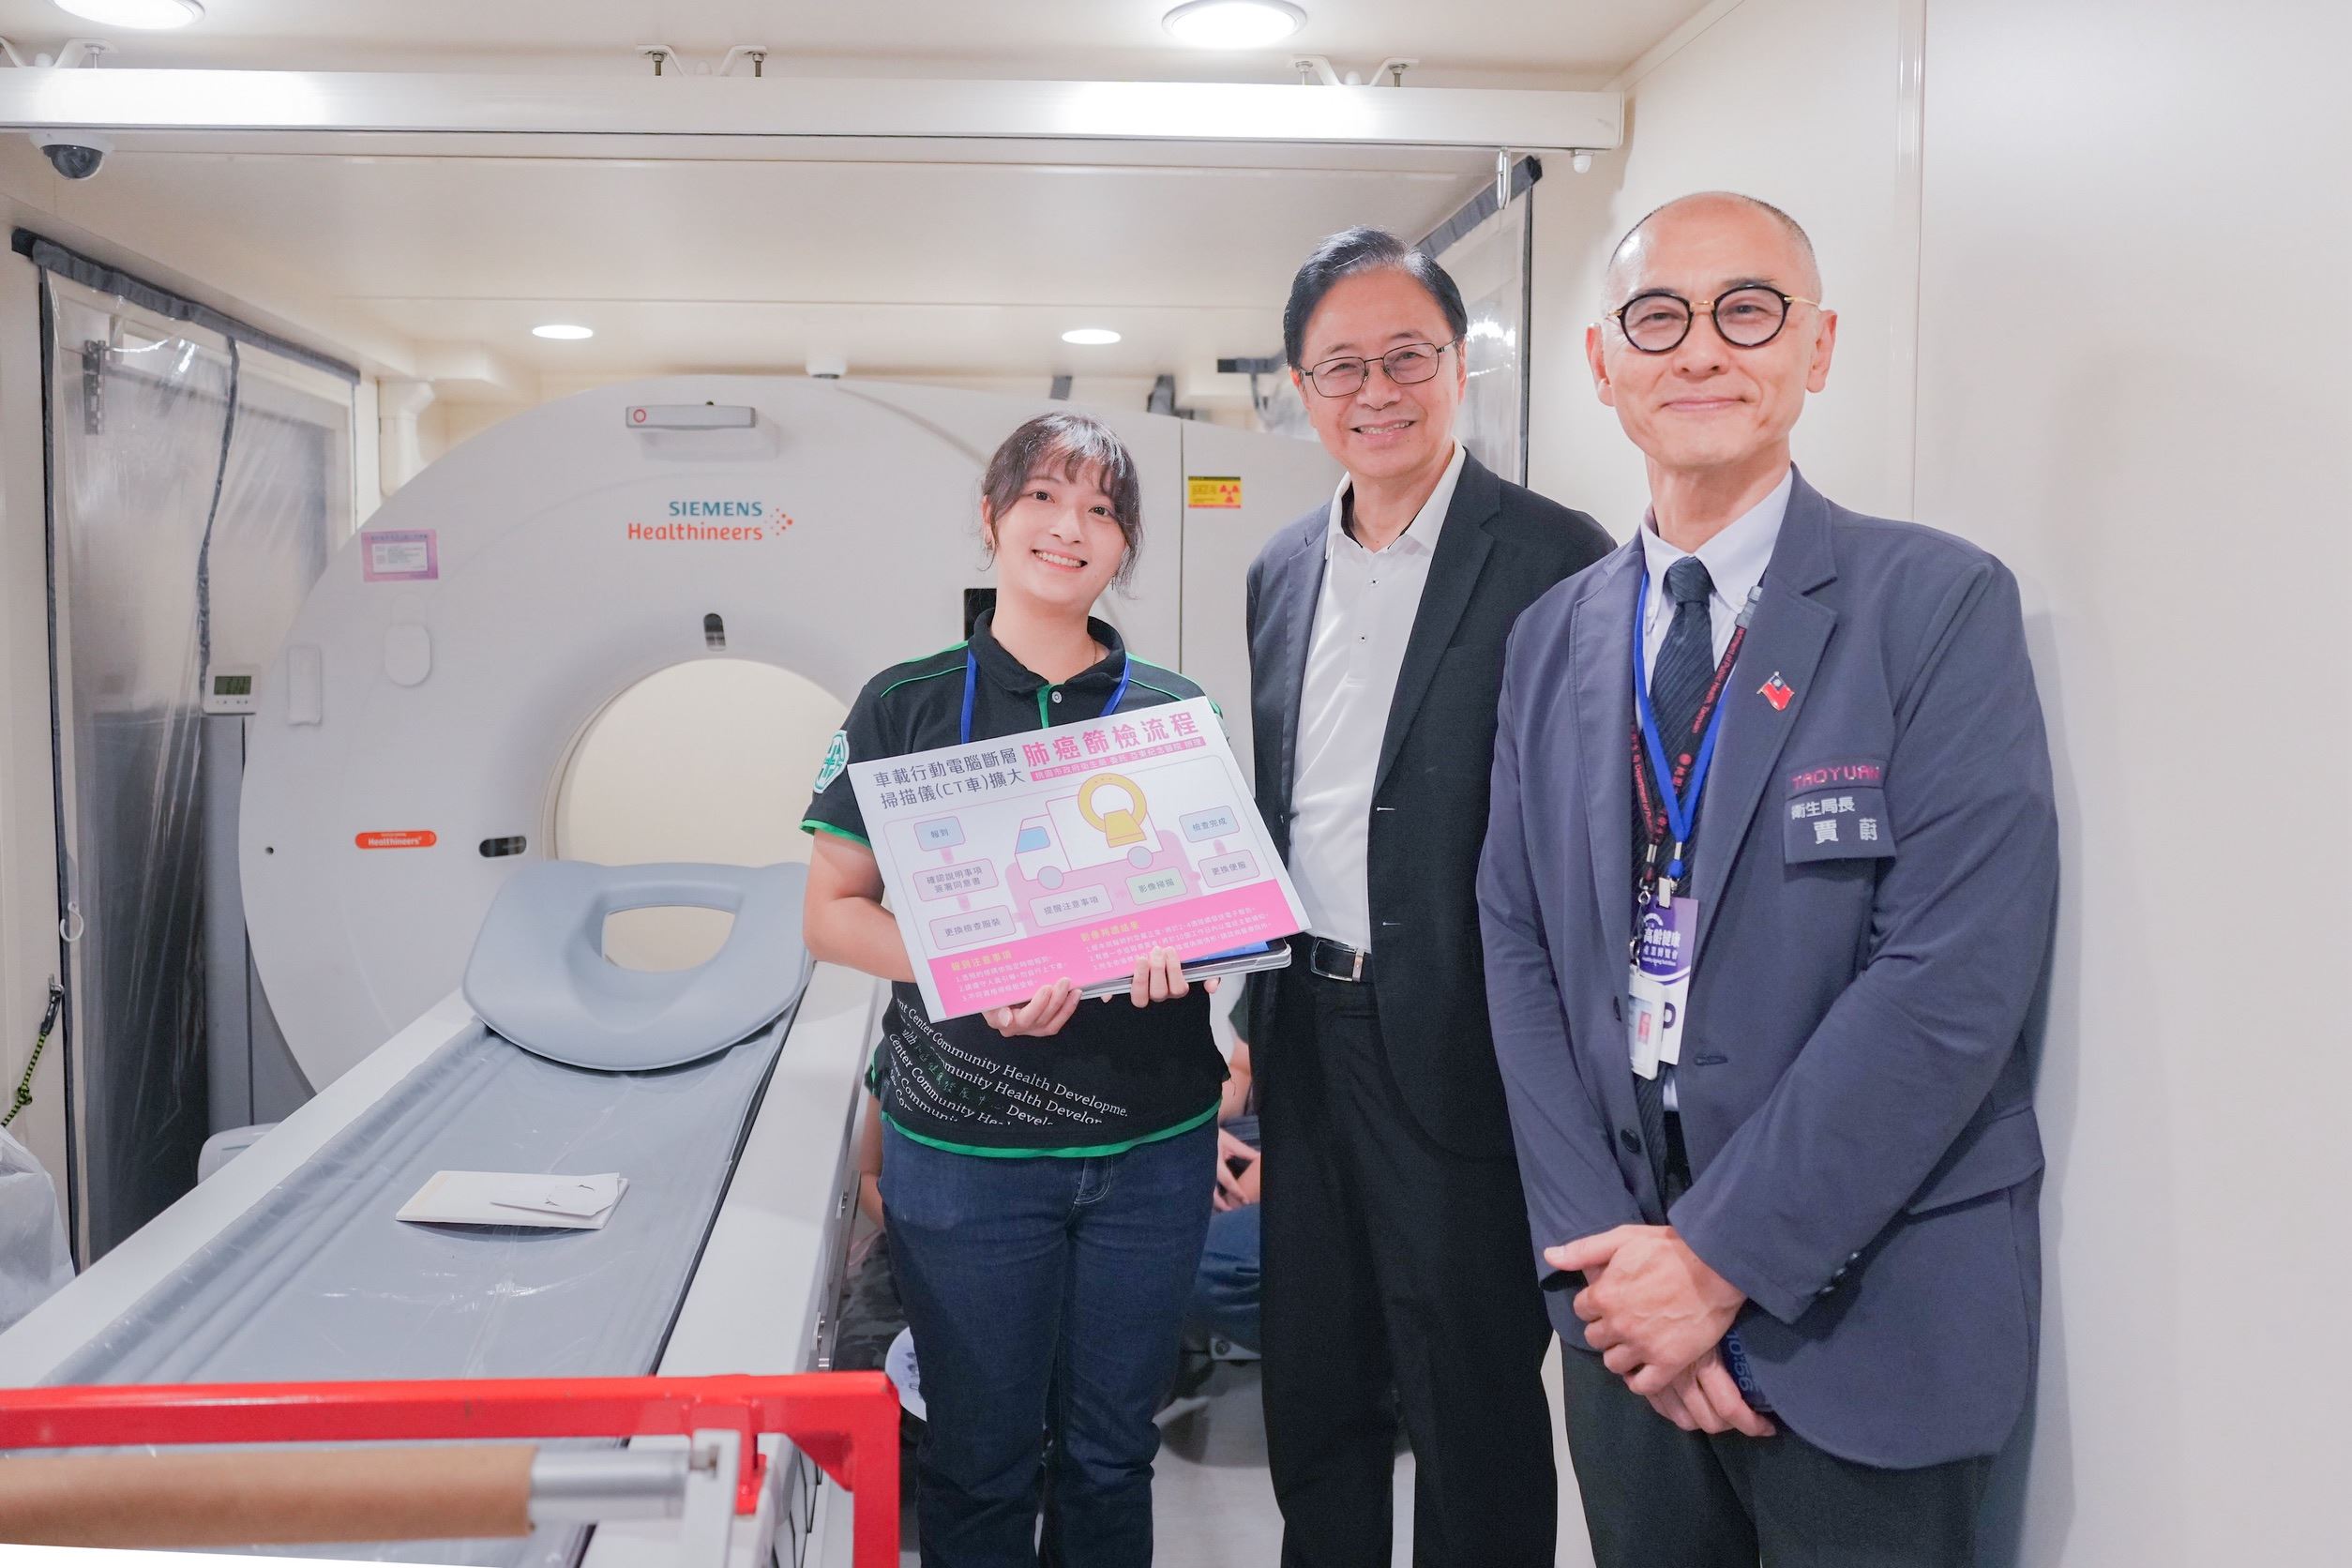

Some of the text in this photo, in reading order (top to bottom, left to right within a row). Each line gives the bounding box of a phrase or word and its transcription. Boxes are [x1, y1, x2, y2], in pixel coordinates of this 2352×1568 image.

[669, 501, 762, 517] SIEMENS
[627, 521, 763, 540] Healthineers
[1021, 711, 1199, 767] 肺癌篩檢流程
[873, 747, 1017, 788] 車載行動電腦斷層
[1791, 764, 1880, 790] TAOYUAN
[881, 768, 1026, 810] 掃描儀(CT車)擴大
[1791, 795, 1856, 820] 衛生局長
[930, 828, 949, 838] 報到
[1192, 817, 1228, 832] 檢查完成
[927, 866, 983, 884] 確認說明事項
[1211, 861, 1246, 876] 更換便服
[1138, 878, 1175, 894] 影像掃描
[1043, 896, 1099, 916] 提醒注意事項
[944, 918, 1001, 937] 更換檢查服裝
[908, 1008, 934, 1036] Center
[932, 1033, 1001, 1075] Community
[1003, 1064, 1050, 1092] Health
[1053, 1083, 1128, 1117] Developme
[889, 1033, 912, 1068] Center
[912, 1067, 975, 1118] Community
[994, 1080, 1042, 1108] Health
